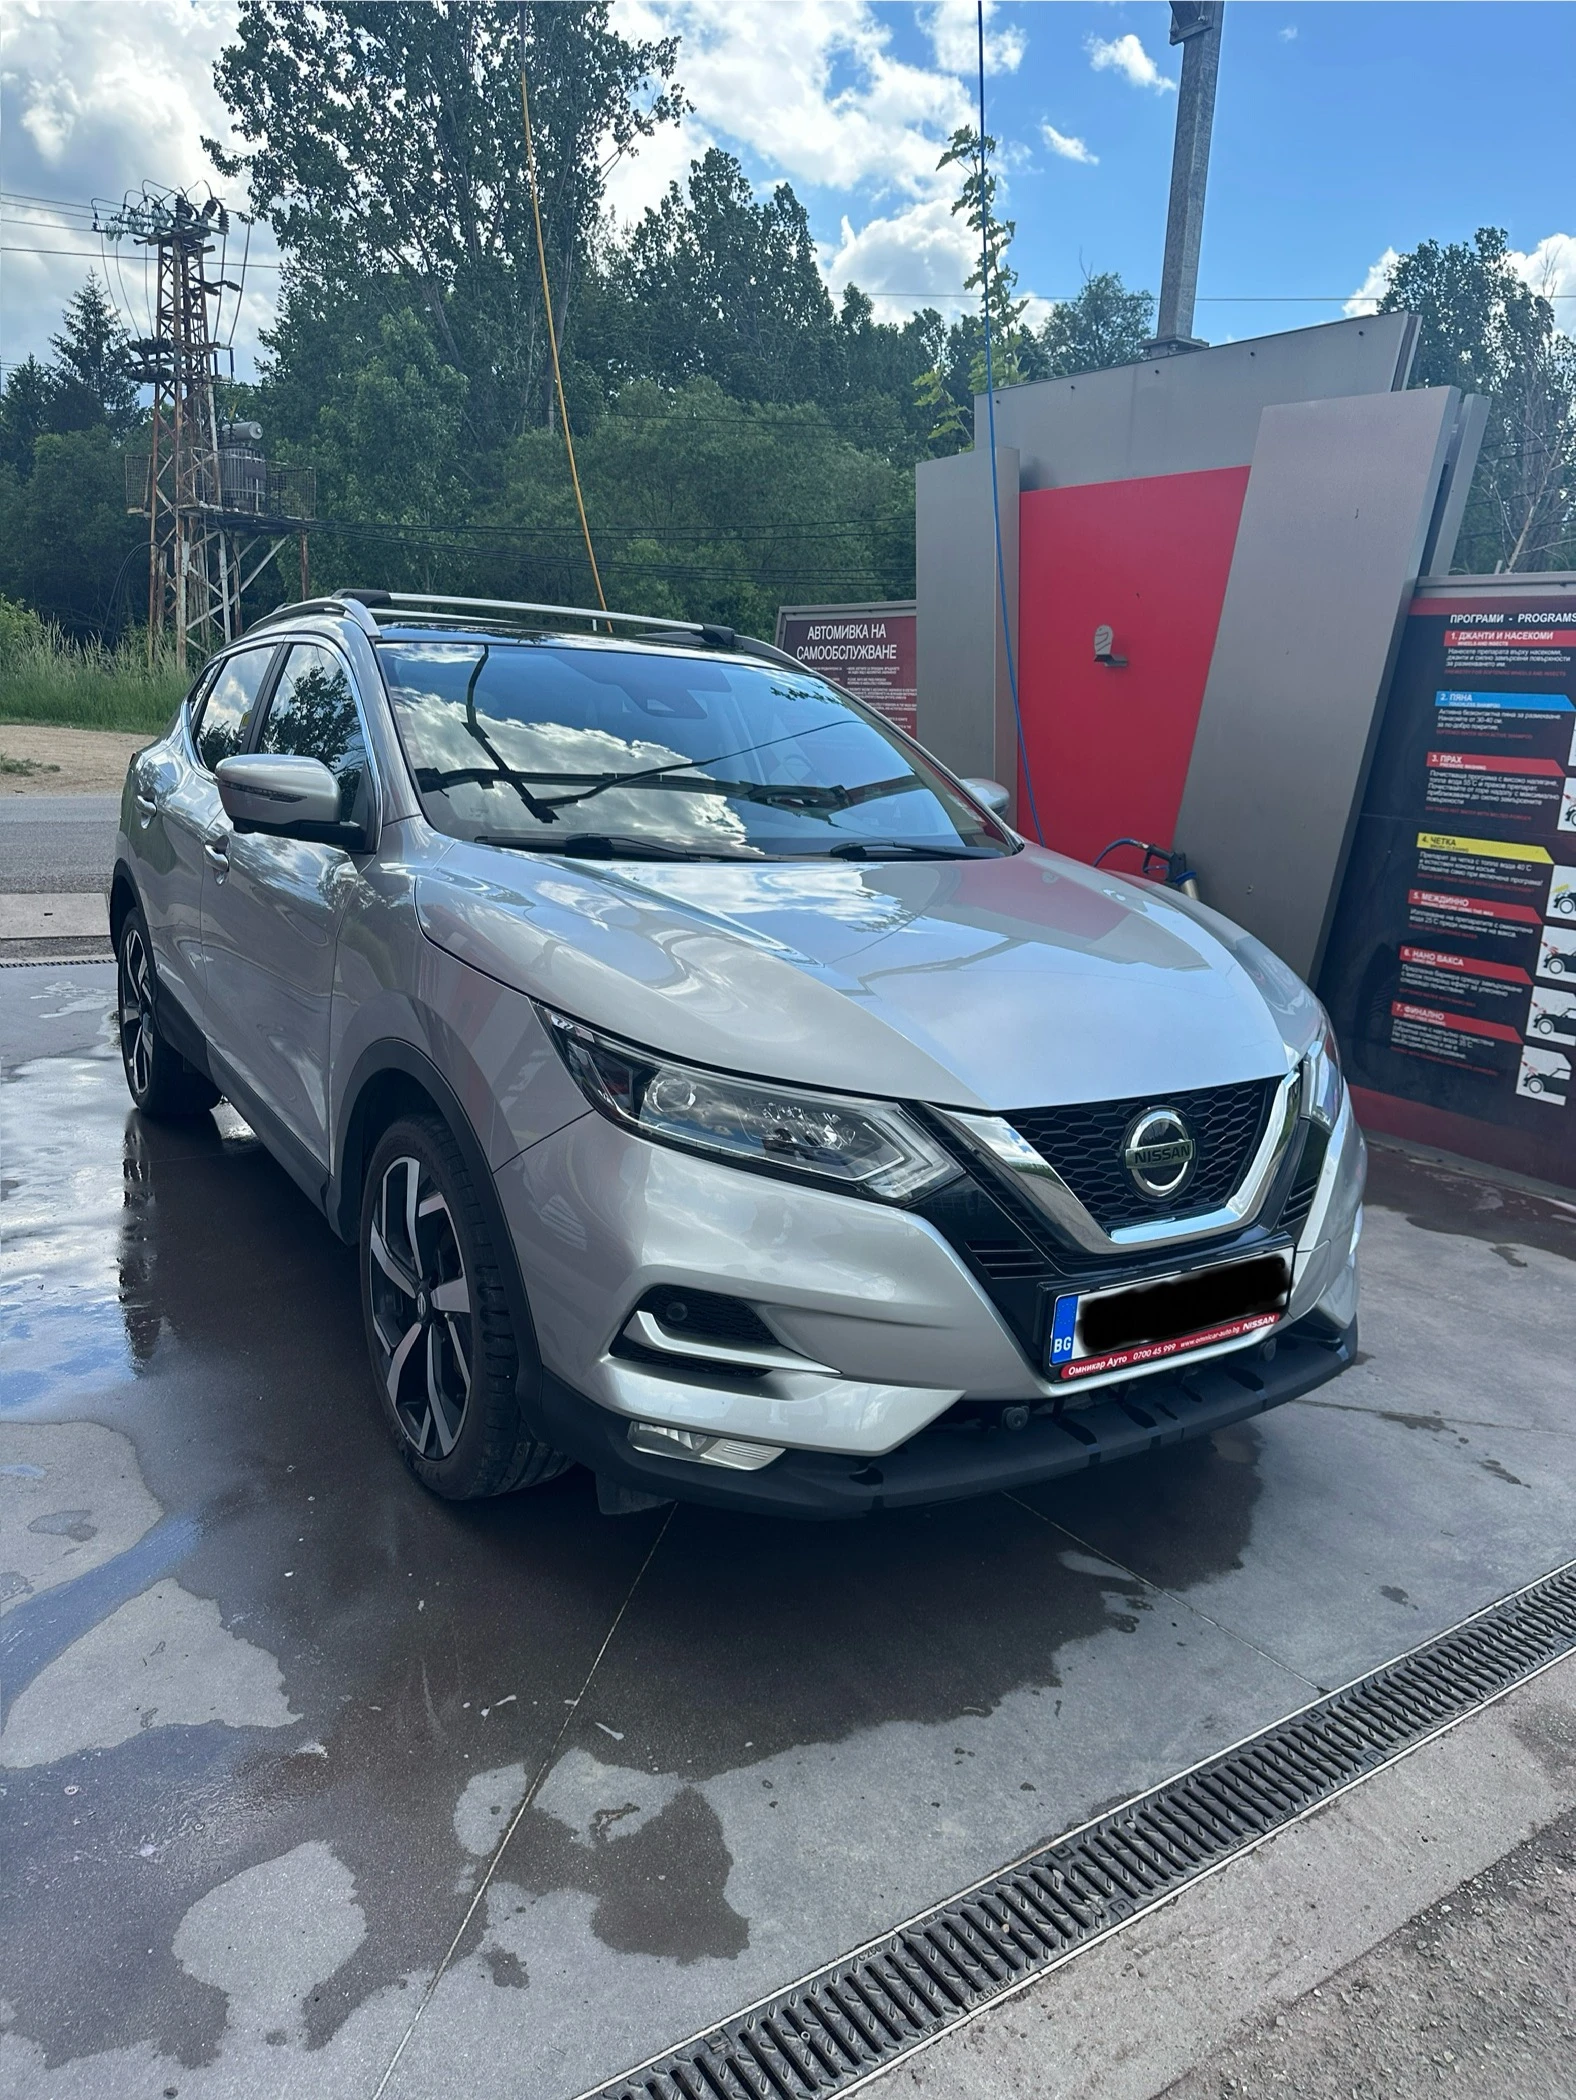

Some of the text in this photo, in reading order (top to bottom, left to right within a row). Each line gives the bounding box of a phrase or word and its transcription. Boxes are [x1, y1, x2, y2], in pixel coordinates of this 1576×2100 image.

[1450, 614, 1504, 623] ПРОГРАМИ
[808, 624, 886, 640] АВТОМИВКА НА
[797, 645, 897, 660] САМООБСЛУЖВАНЕ
[1431, 837, 1456, 846] ЧЕТКА
[1421, 893, 1469, 907] МЕЖДИННО
[1412, 950, 1436, 960] НАНО
[1437, 955, 1464, 966] ВАКСА
[1396, 1004, 1403, 1012] 7.
[1404, 1006, 1444, 1020] ФИНАЛНО
[1135, 1145, 1189, 1164] NISSAN
[1054, 1337, 1071, 1353] BG
[1068, 1315, 1274, 1376] Омникар Ауто 0700 45 999 www.omnicar-auto.bg NISSAN
